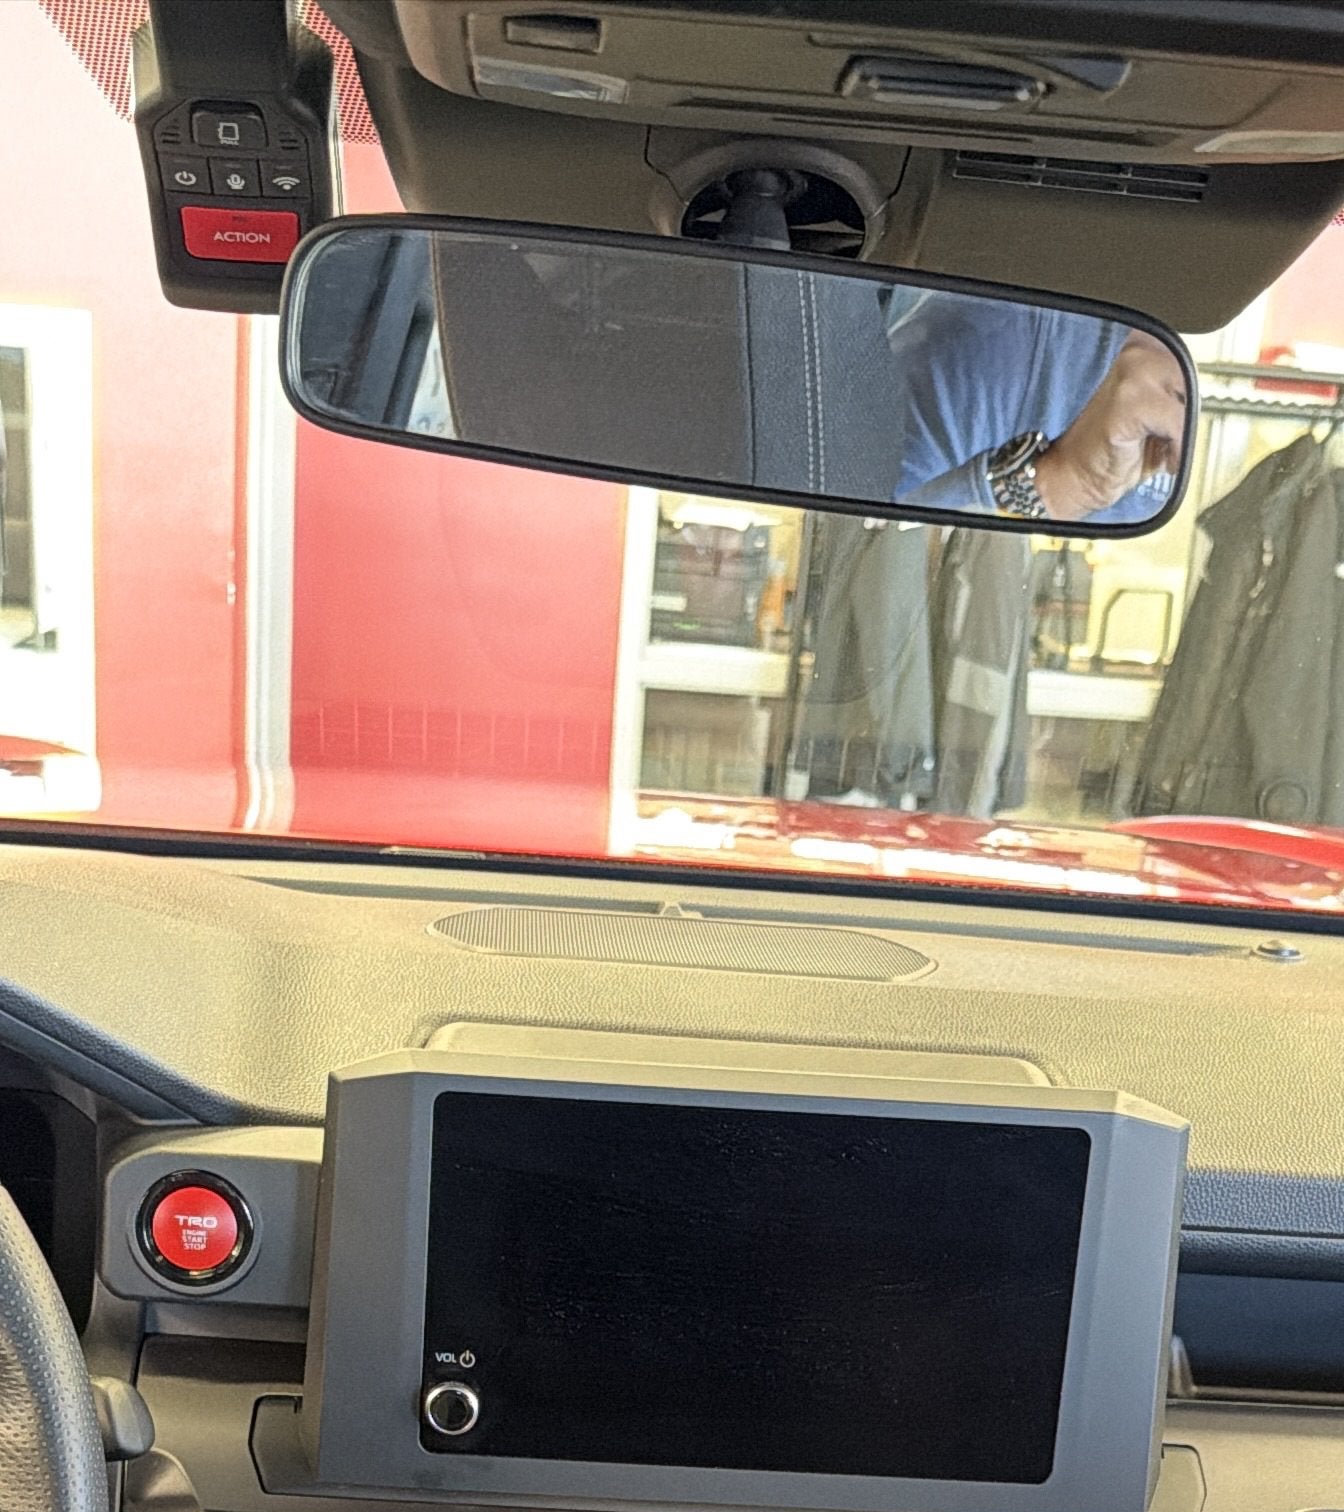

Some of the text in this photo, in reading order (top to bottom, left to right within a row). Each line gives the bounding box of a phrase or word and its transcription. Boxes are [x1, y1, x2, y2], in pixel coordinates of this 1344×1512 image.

[213, 231, 271, 244] ACTION
[174, 1214, 218, 1229] TRD
[183, 1242, 207, 1251] STOP
[435, 1352, 457, 1364] VOL
